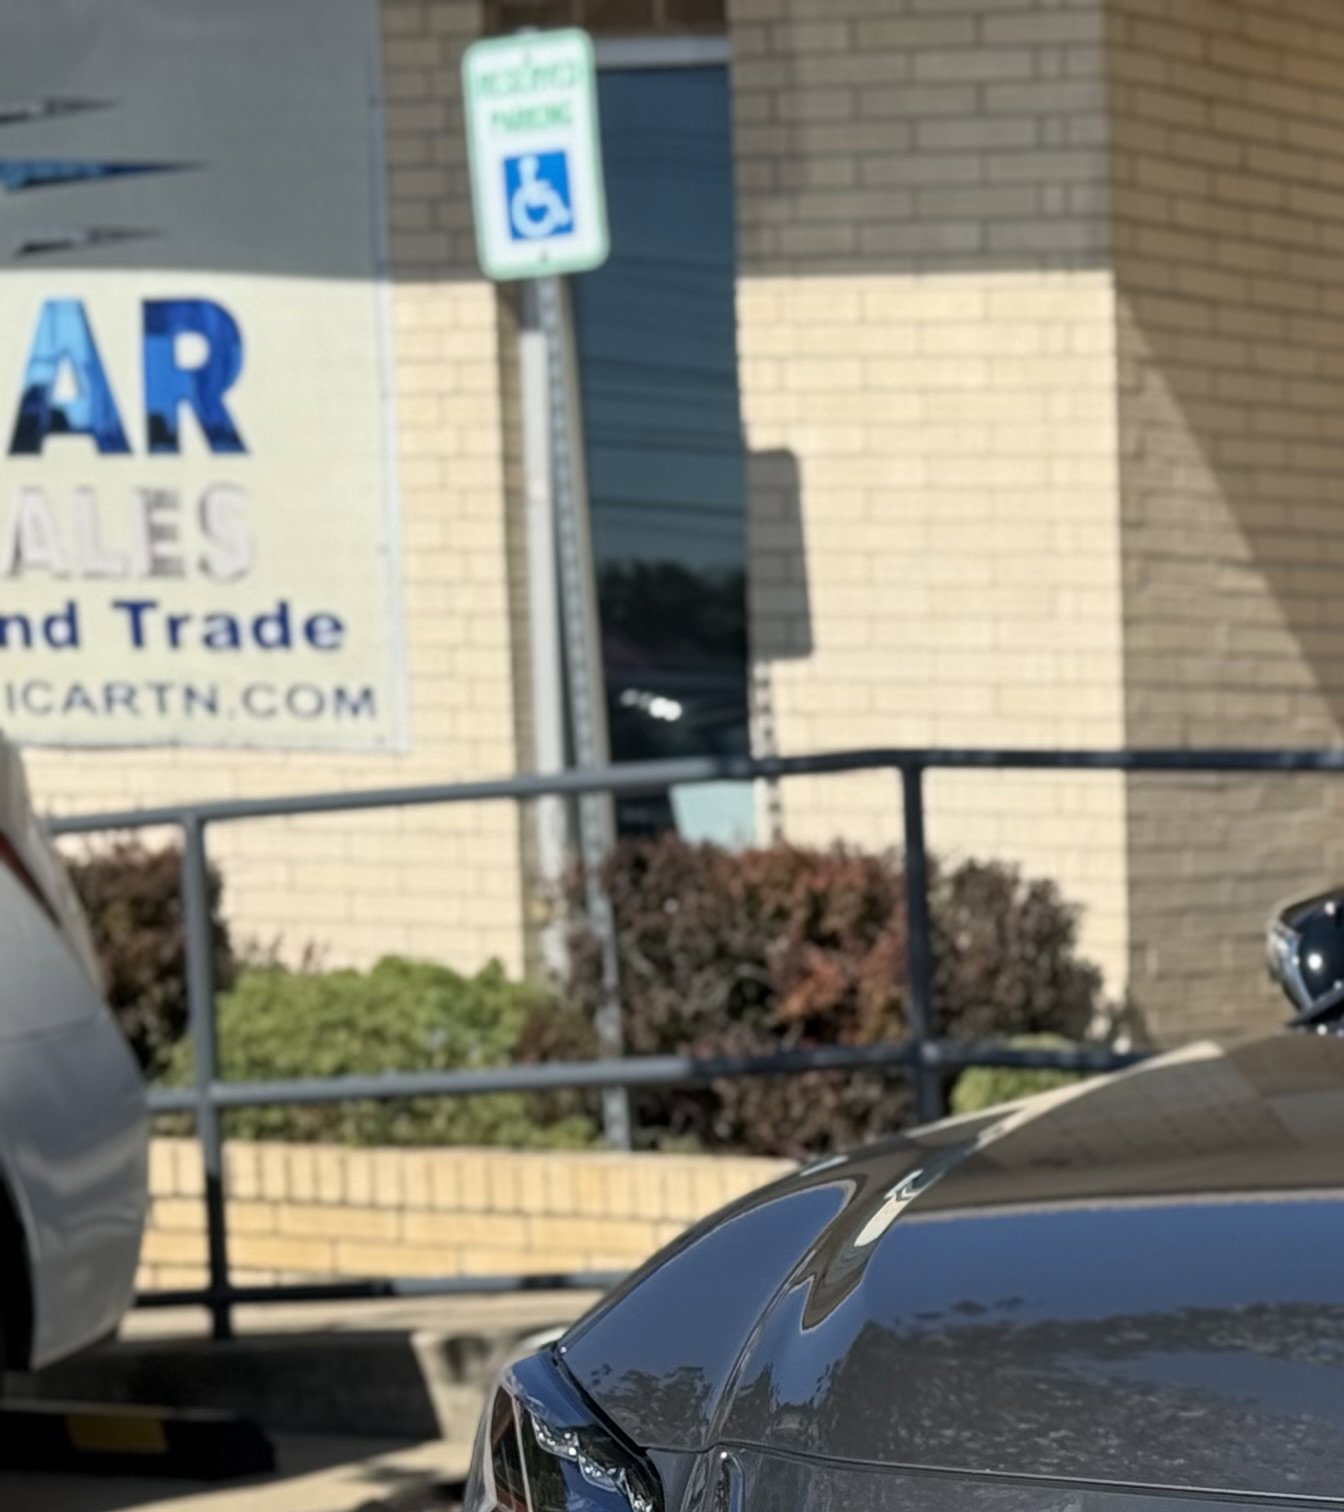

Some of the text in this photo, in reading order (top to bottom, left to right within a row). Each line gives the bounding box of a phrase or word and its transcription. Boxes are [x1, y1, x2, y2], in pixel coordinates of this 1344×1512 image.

[8, 298, 249, 456] AR
[5, 482, 256, 584] ALES
[111, 600, 345, 651] Trade
[5, 680, 376, 720] ICARTN.COM
